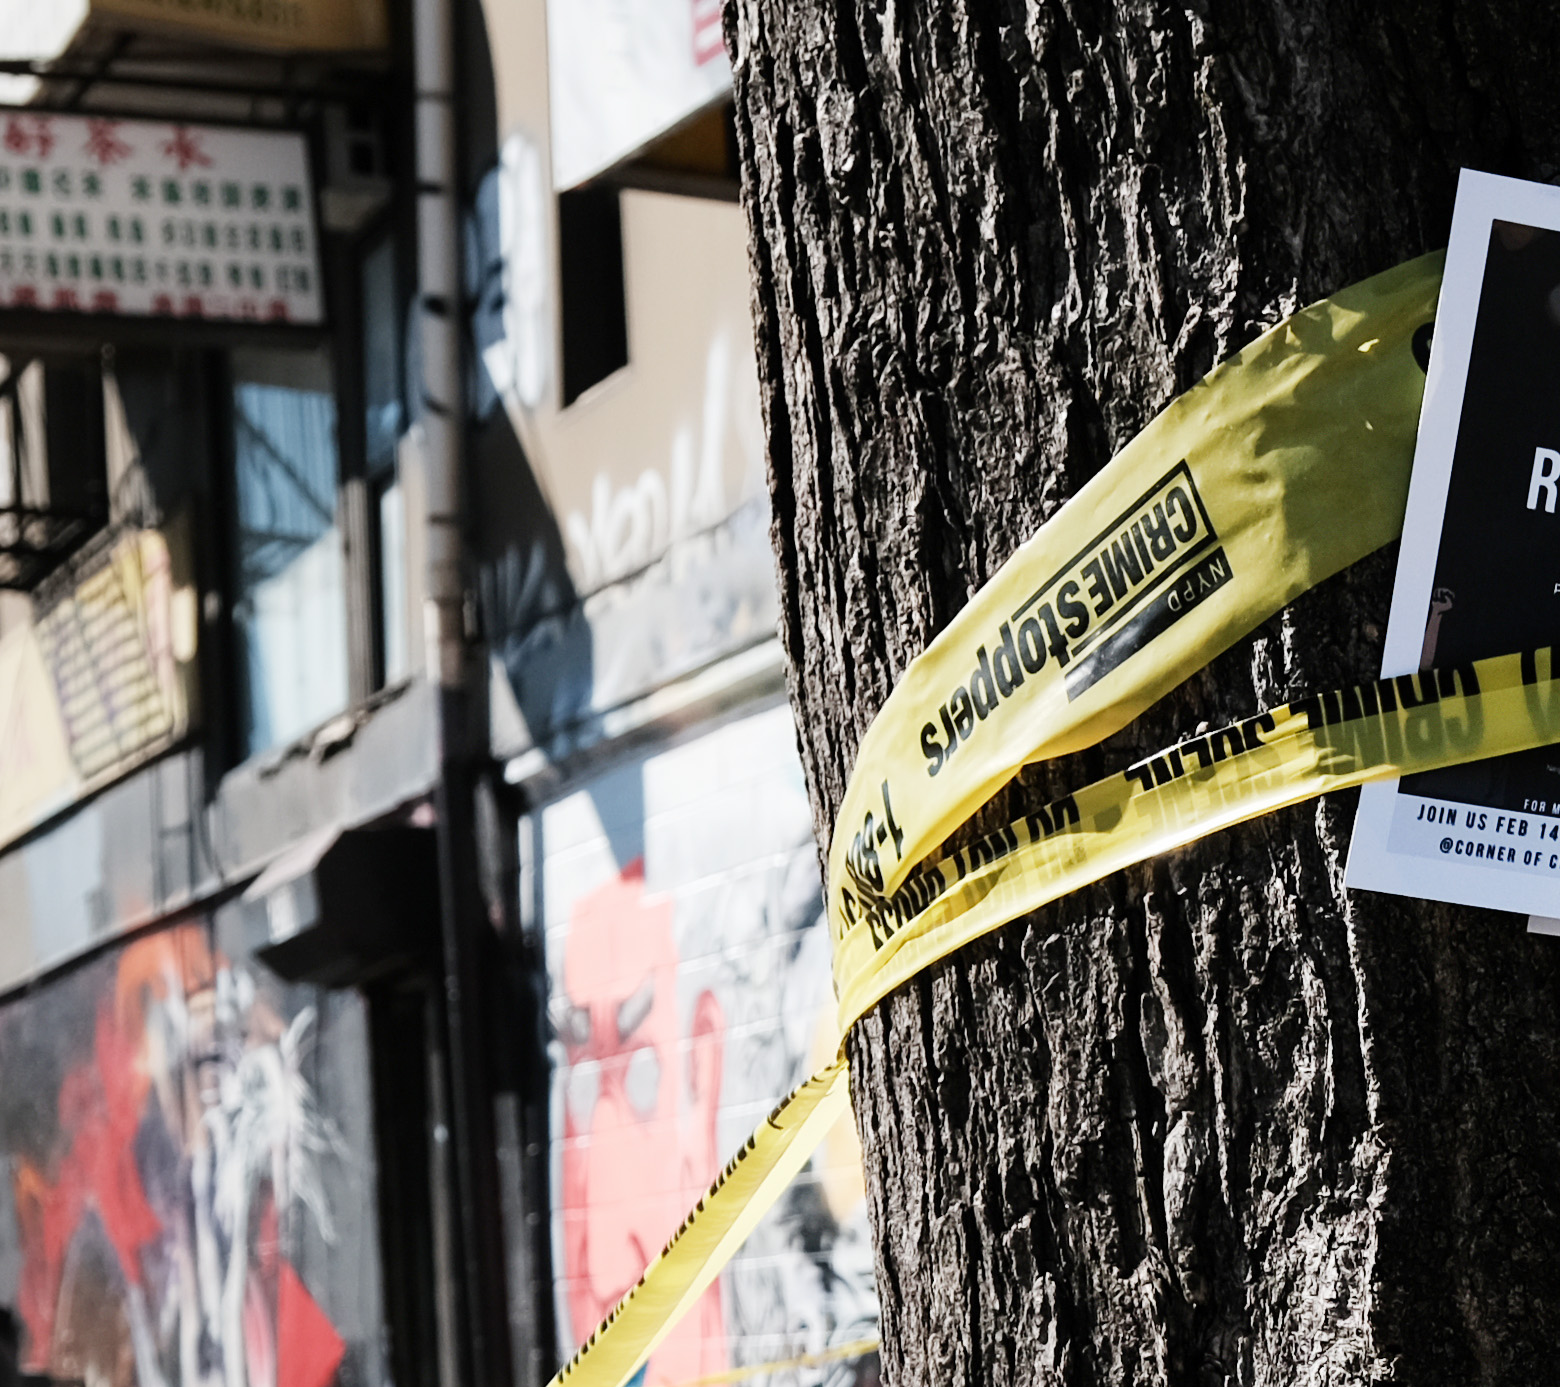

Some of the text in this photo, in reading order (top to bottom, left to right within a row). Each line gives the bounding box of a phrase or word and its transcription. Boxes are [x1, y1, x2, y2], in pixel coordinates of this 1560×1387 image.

[1167, 560, 1226, 612] NYPD
[1523, 799, 1546, 812] FOR
[1417, 804, 1457, 826] JOIN
[1465, 811, 1488, 831] US
[1496, 816, 1529, 837] FEB
[1539, 823, 1559, 841] 14
[1439, 837, 1516, 863] @CORNER
[1523, 850, 1543, 866] OF
